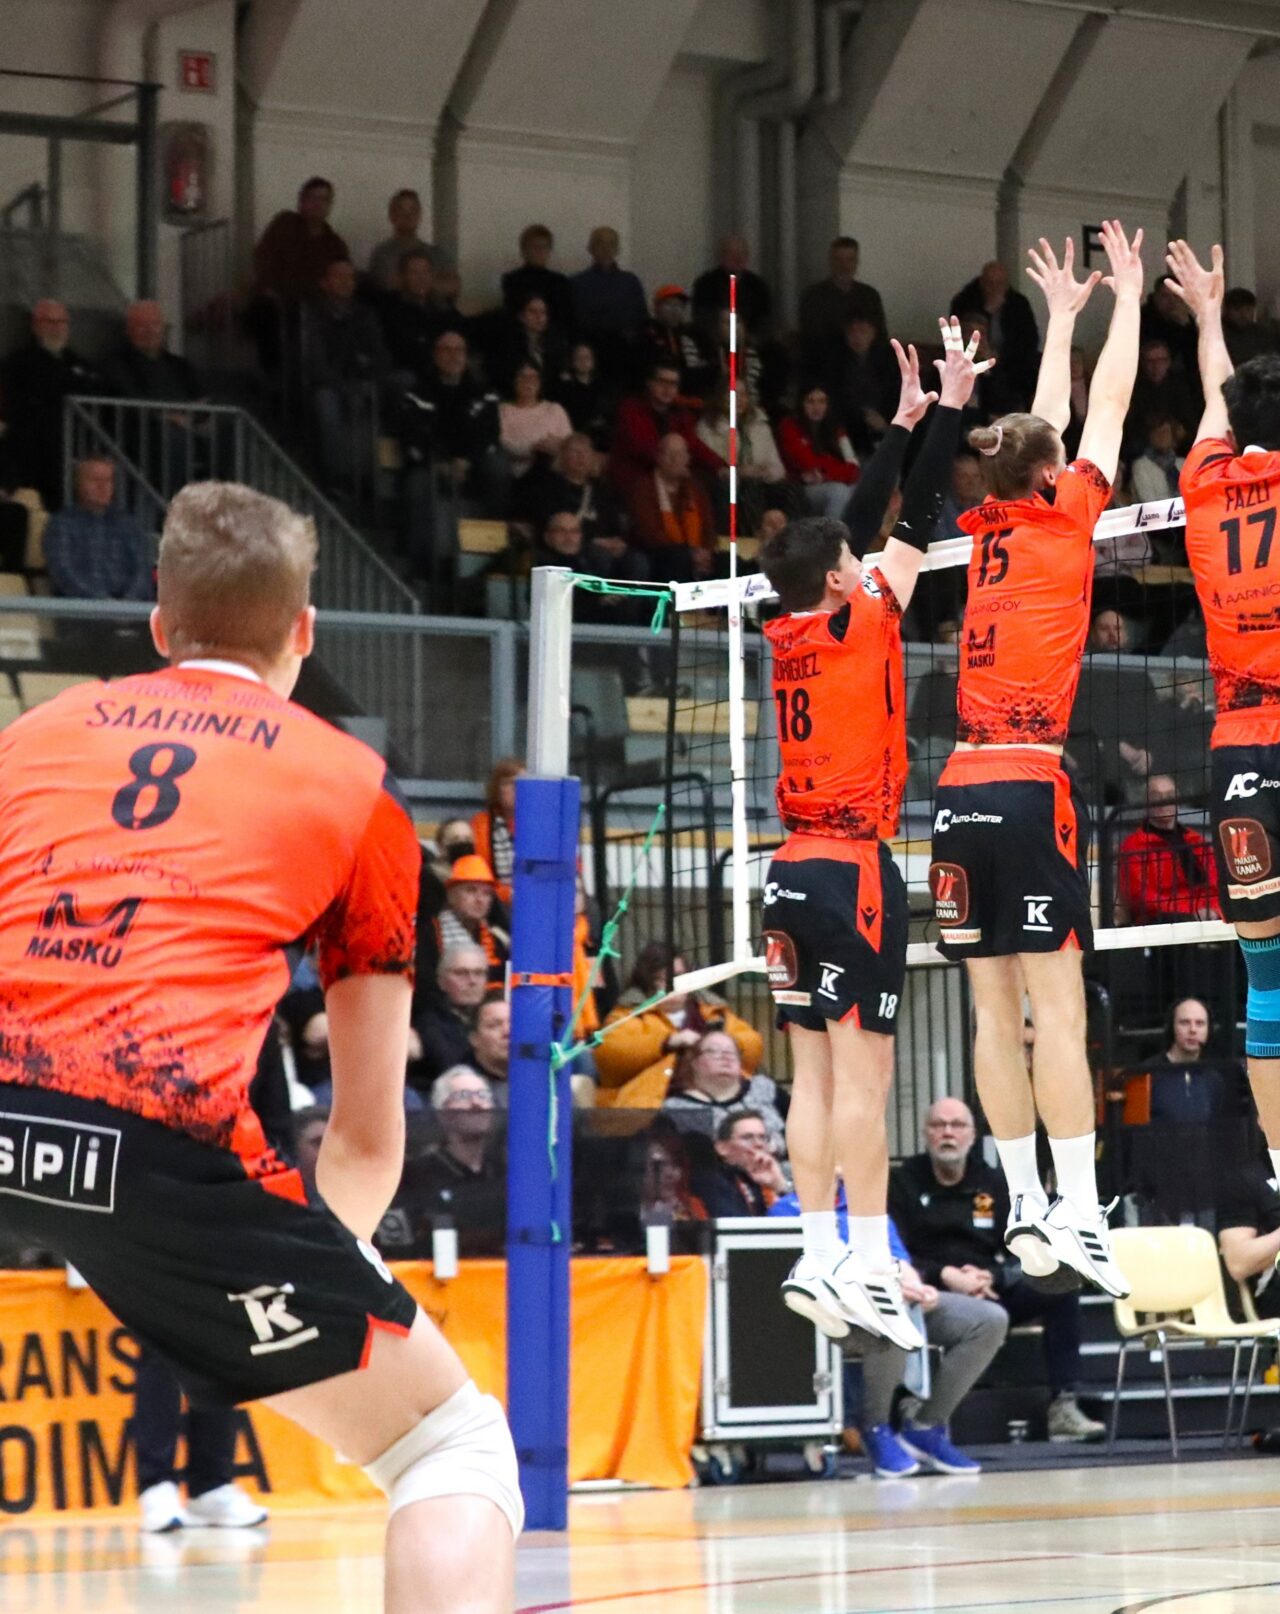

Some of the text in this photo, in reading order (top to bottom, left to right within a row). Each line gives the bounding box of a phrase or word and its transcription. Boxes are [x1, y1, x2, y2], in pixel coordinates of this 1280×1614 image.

[977, 528, 1015, 588] 15
[1219, 506, 1277, 576] 17
[1003, 600, 1021, 612] OY
[87, 700, 281, 750] SAARINEN
[776, 687, 813, 743] 18
[111, 742, 197, 830] 8
[1223, 771, 1260, 801] AC
[25, 936, 123, 970] MASKU
[877, 991, 899, 1019] 18
[0, 1328, 140, 1401] ANS
